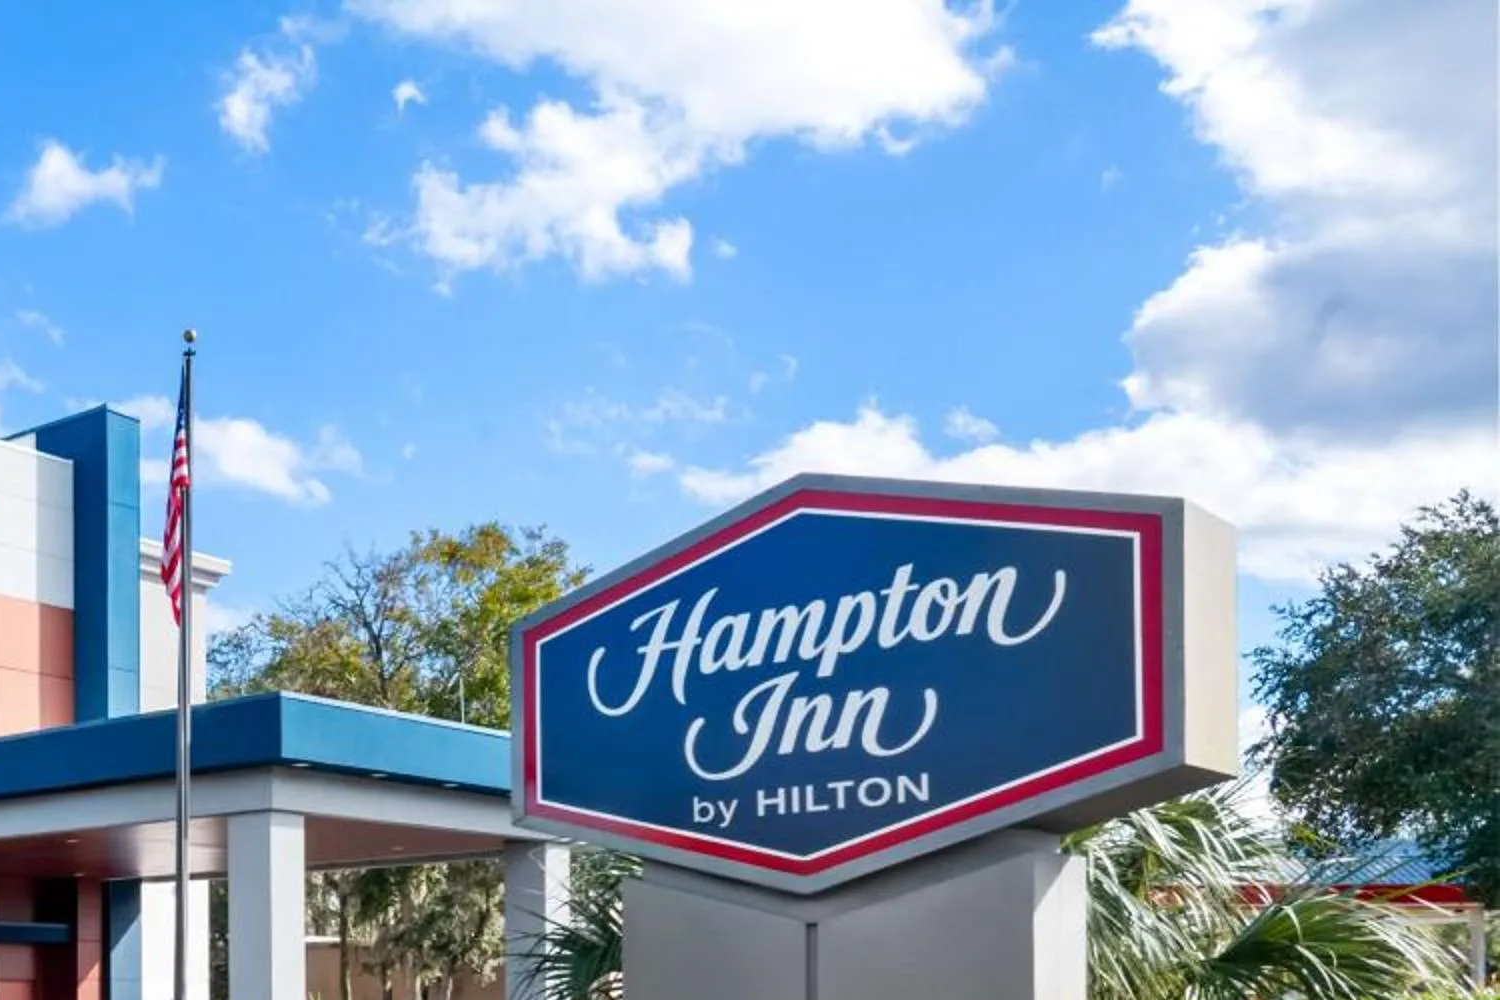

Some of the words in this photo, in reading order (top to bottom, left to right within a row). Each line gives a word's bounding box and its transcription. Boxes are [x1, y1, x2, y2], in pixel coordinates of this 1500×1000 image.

[588, 563, 1065, 717] Hampton
[685, 671, 937, 780] Inn
[693, 795, 738, 828] by
[757, 773, 929, 817] HILTON
